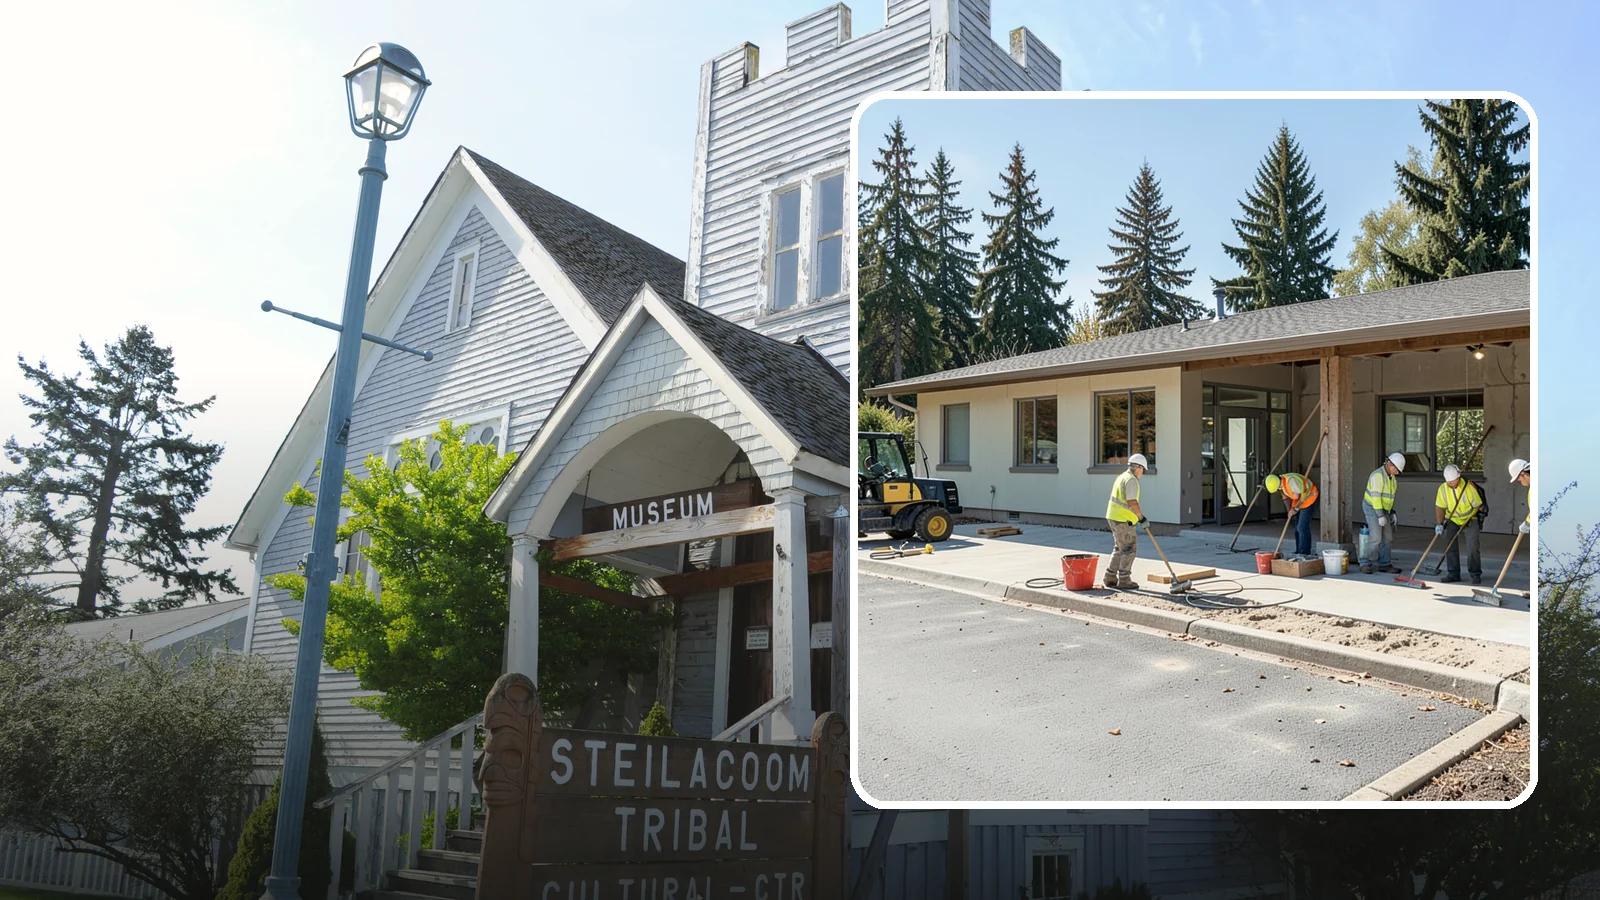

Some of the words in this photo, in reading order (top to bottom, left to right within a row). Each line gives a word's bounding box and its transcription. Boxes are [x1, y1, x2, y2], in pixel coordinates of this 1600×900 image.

[613, 491, 713, 531] MUSEUM
[550, 738, 809, 792] STEILACOOM
[615, 806, 758, 852] TRIBAL
